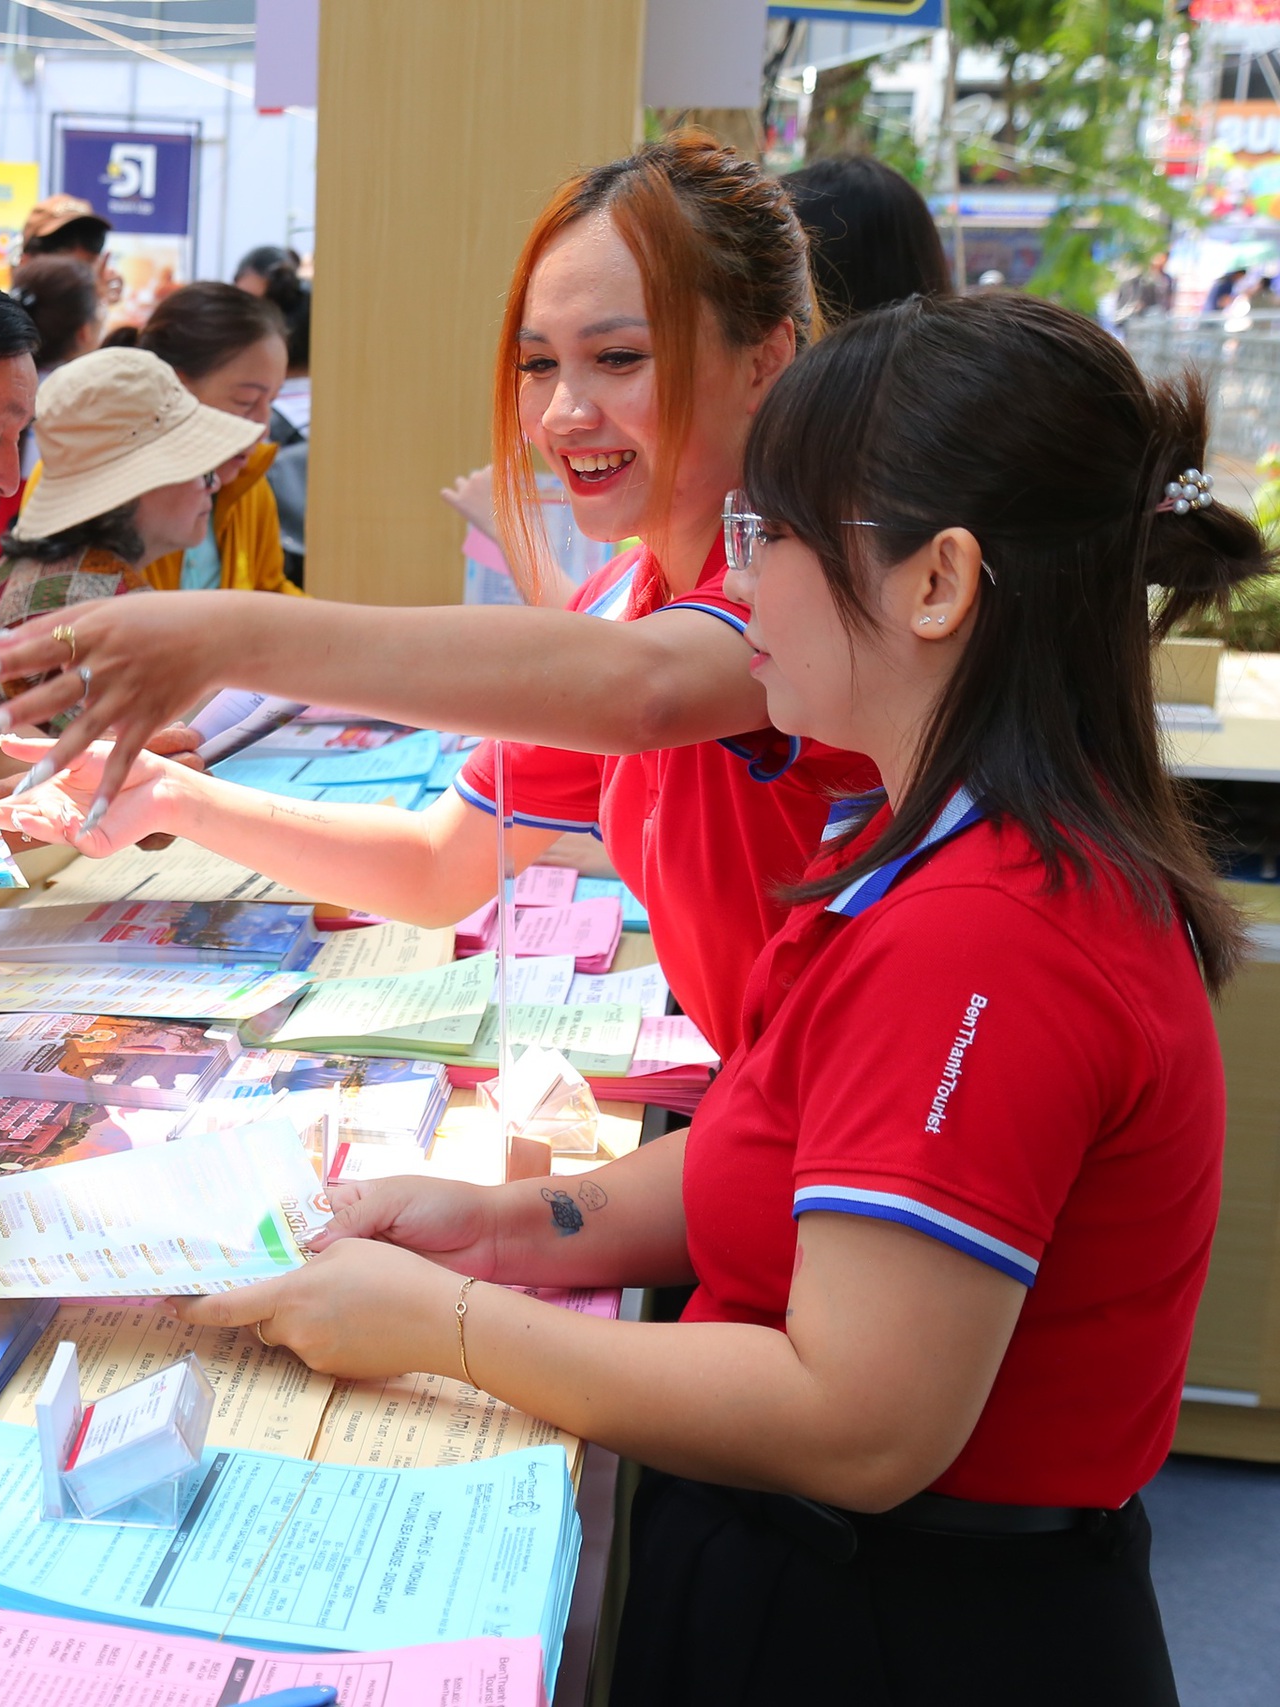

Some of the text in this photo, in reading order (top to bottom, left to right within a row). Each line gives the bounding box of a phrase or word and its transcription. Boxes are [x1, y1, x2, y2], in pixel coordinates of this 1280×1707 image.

[925, 993, 988, 1134] BenThanhTourist
[206, 1350, 235, 1364] HẢI
[215, 1346, 255, 1418] CHÙM TOUR KHÁM PHÁ TRUNG HOA
[448, 1412, 476, 1420] Ô
[452, 1395, 481, 1409] HẢI
[442, 1419, 474, 1439] TRẤN
[471, 1404, 496, 1454] TOUR KHÁM PHÁ TRUNG
[515, 1479, 526, 1500] Tourist
[526, 1461, 537, 1501] BenThanh
[398, 1524, 414, 1535] SEA
[402, 1507, 420, 1523] CUNG
[423, 1510, 442, 1530] TOKYO
[387, 1536, 410, 1567] PARADISE
[371, 1572, 398, 1614] DISNEYLAND
[401, 1561, 426, 1596] YOKOHAMA
[482, 1673, 498, 1704] Tourist
[492, 1657, 512, 1703] BenThanh
